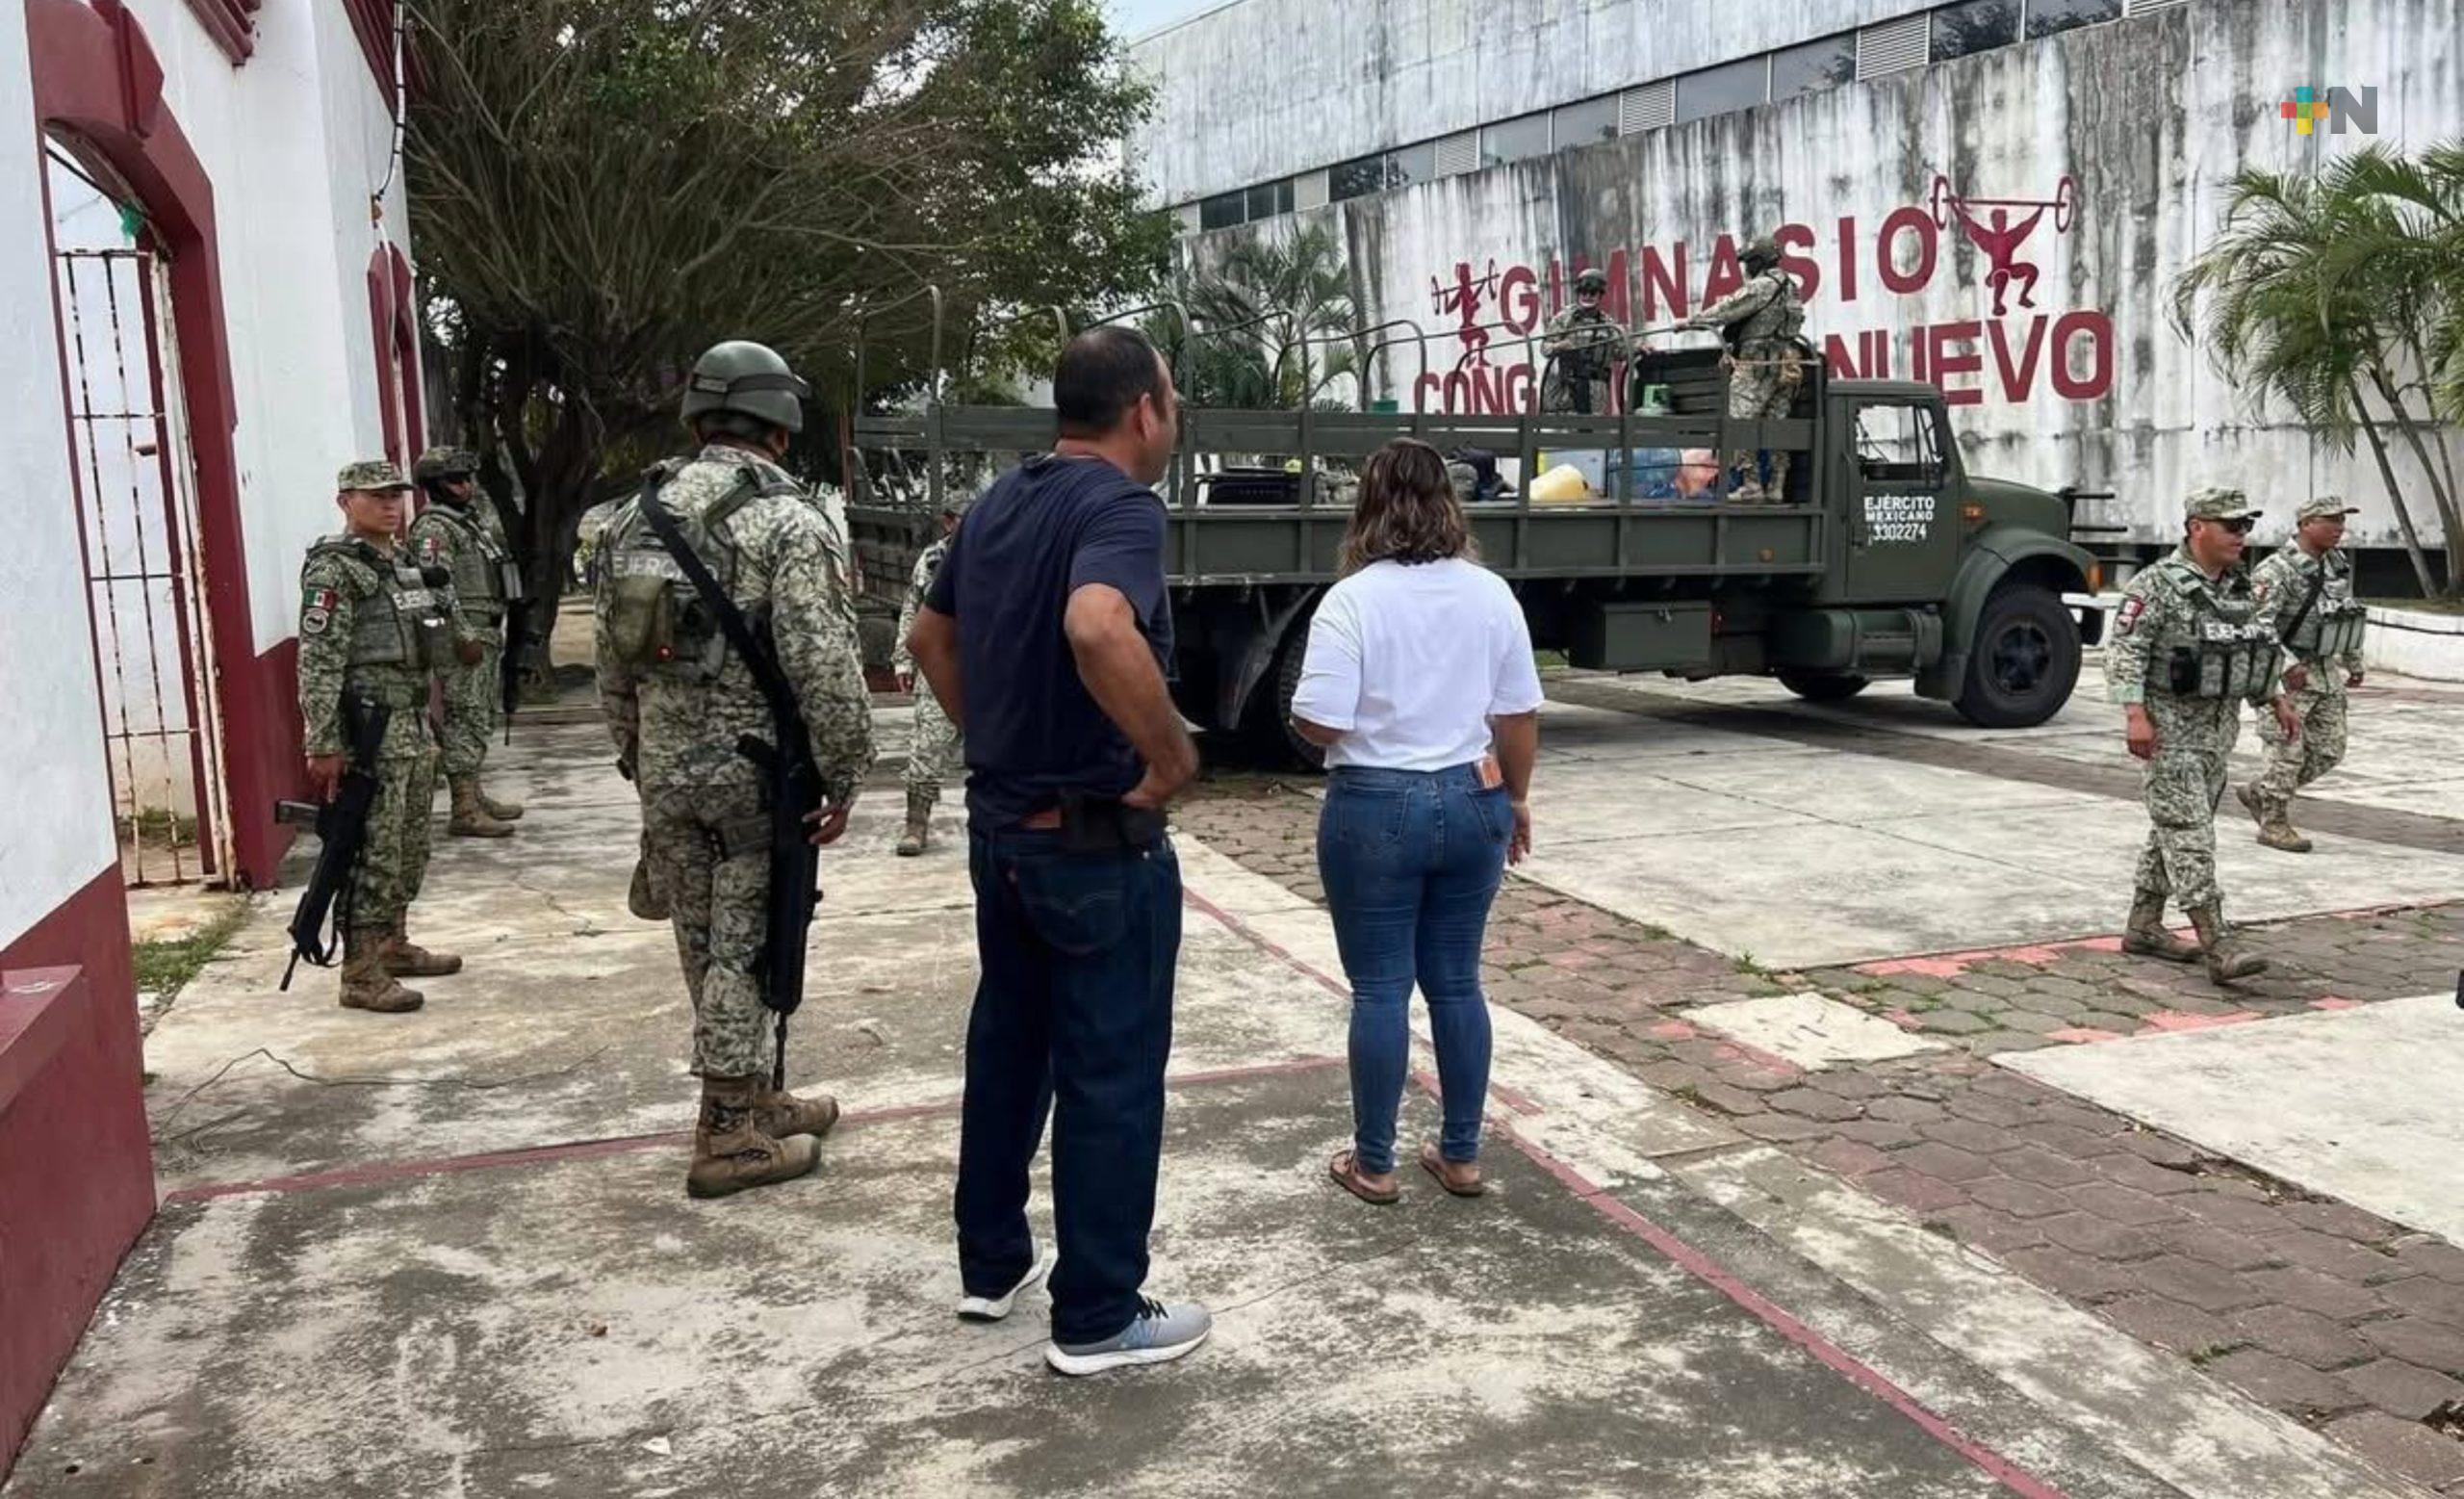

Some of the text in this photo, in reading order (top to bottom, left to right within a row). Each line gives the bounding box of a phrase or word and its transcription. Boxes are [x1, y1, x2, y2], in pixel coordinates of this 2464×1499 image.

[1825, 310, 2113, 405] NUEVO
[1863, 493, 1935, 510] EJÉRCITO
[1865, 510, 1934, 522] MEXICANO
